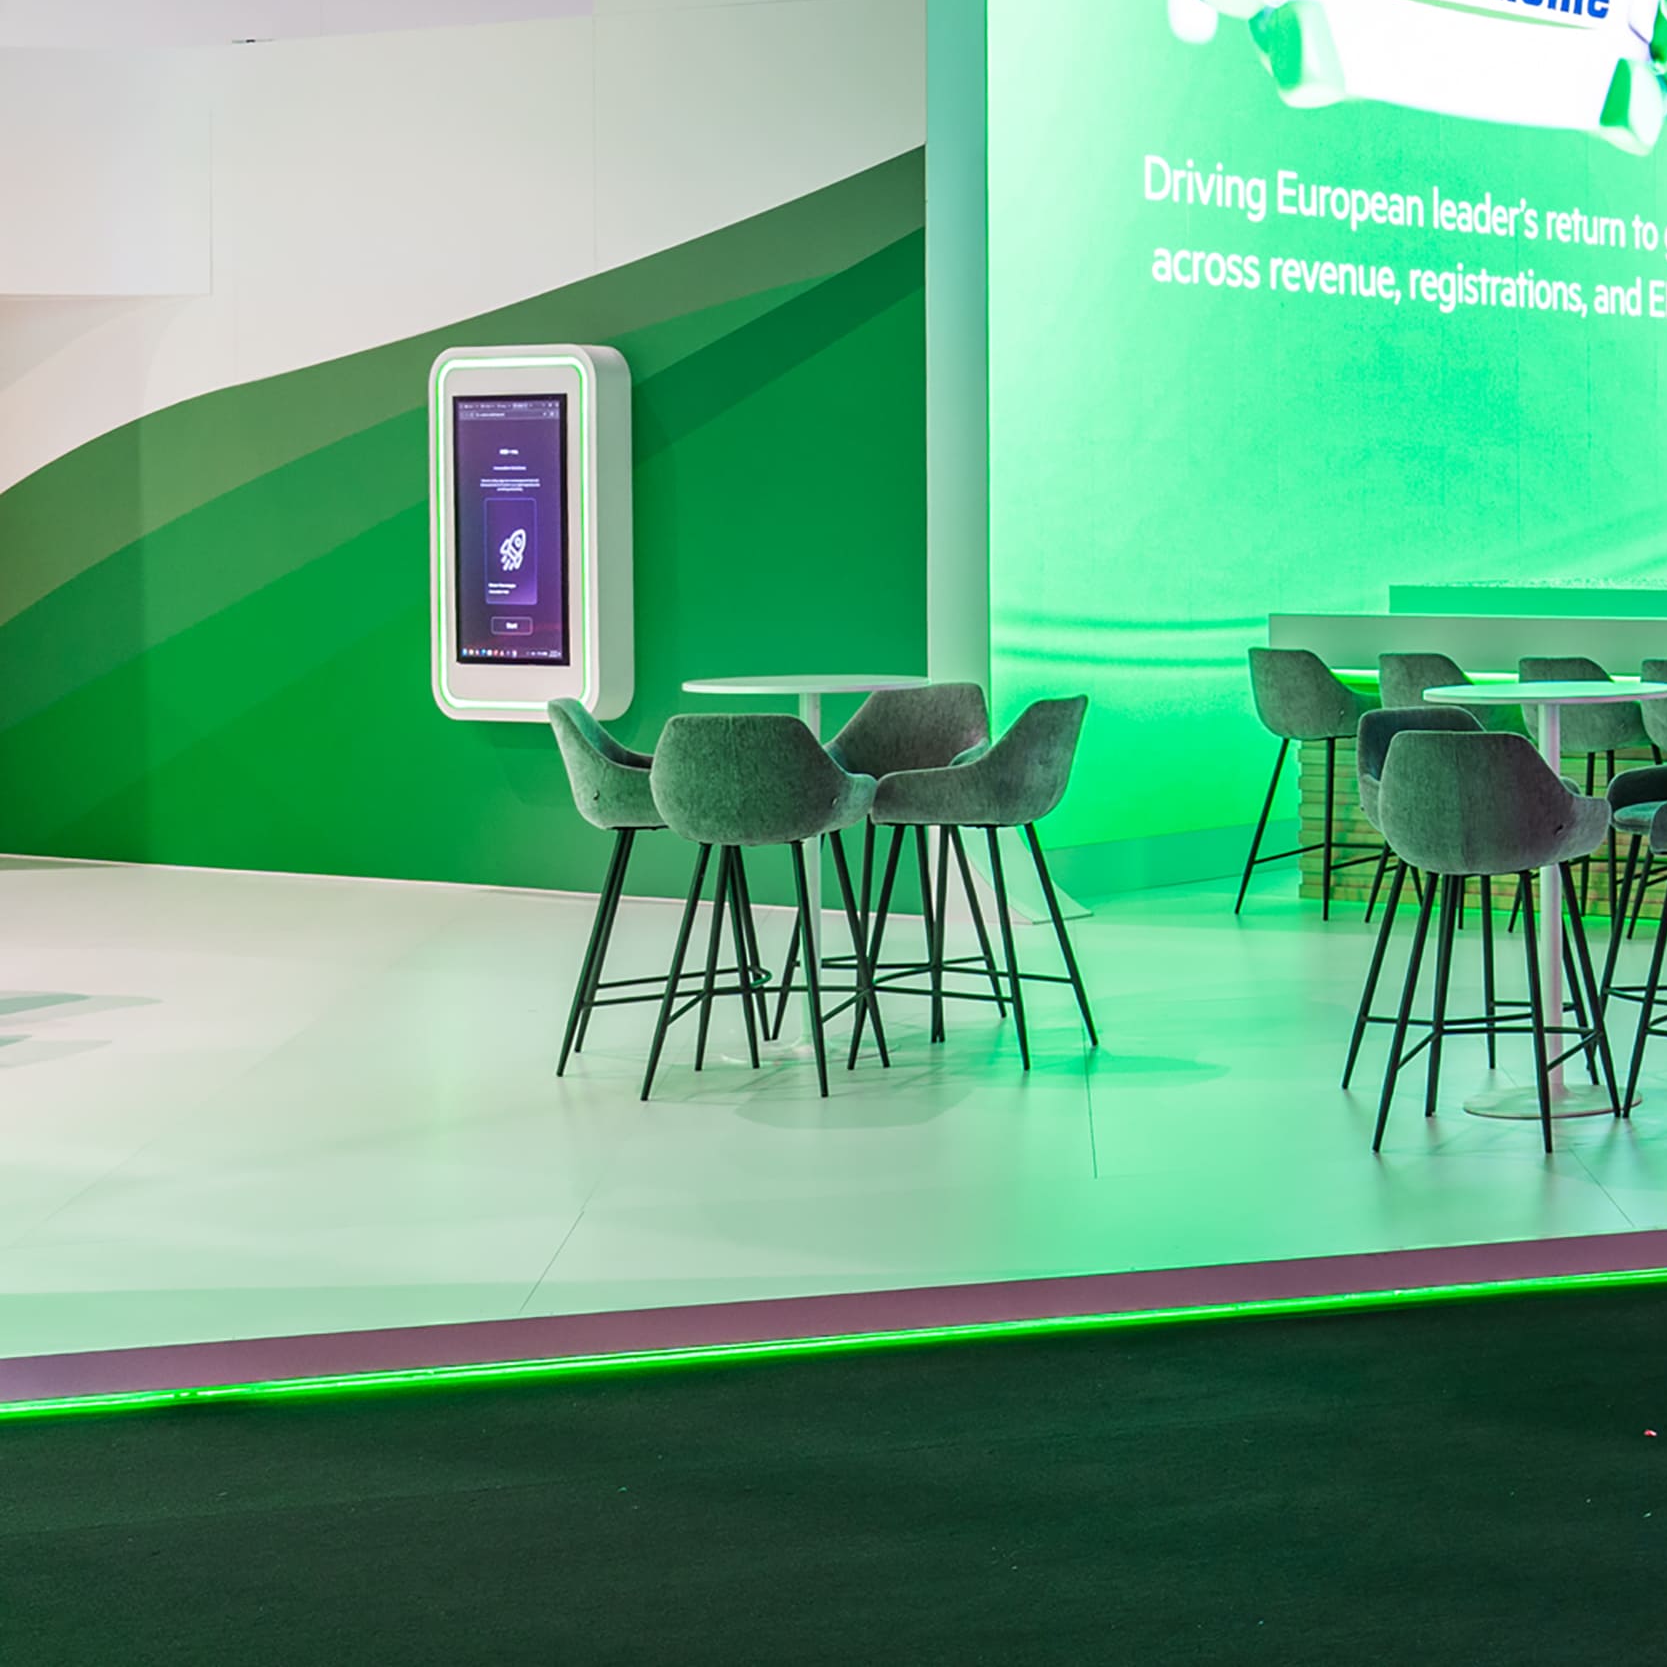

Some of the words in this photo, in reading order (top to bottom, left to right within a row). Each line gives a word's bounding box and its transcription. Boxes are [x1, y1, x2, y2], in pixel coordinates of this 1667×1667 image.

[1144, 153, 1267, 222] Driving
[1277, 169, 1424, 231] European
[1546, 207, 1625, 248] return
[1632, 214, 1659, 251] to
[1151, 247, 1260, 289] across
[1270, 256, 1401, 305] revenue,
[1409, 262, 1588, 318] registrations,
[1594, 276, 1642, 316] and
